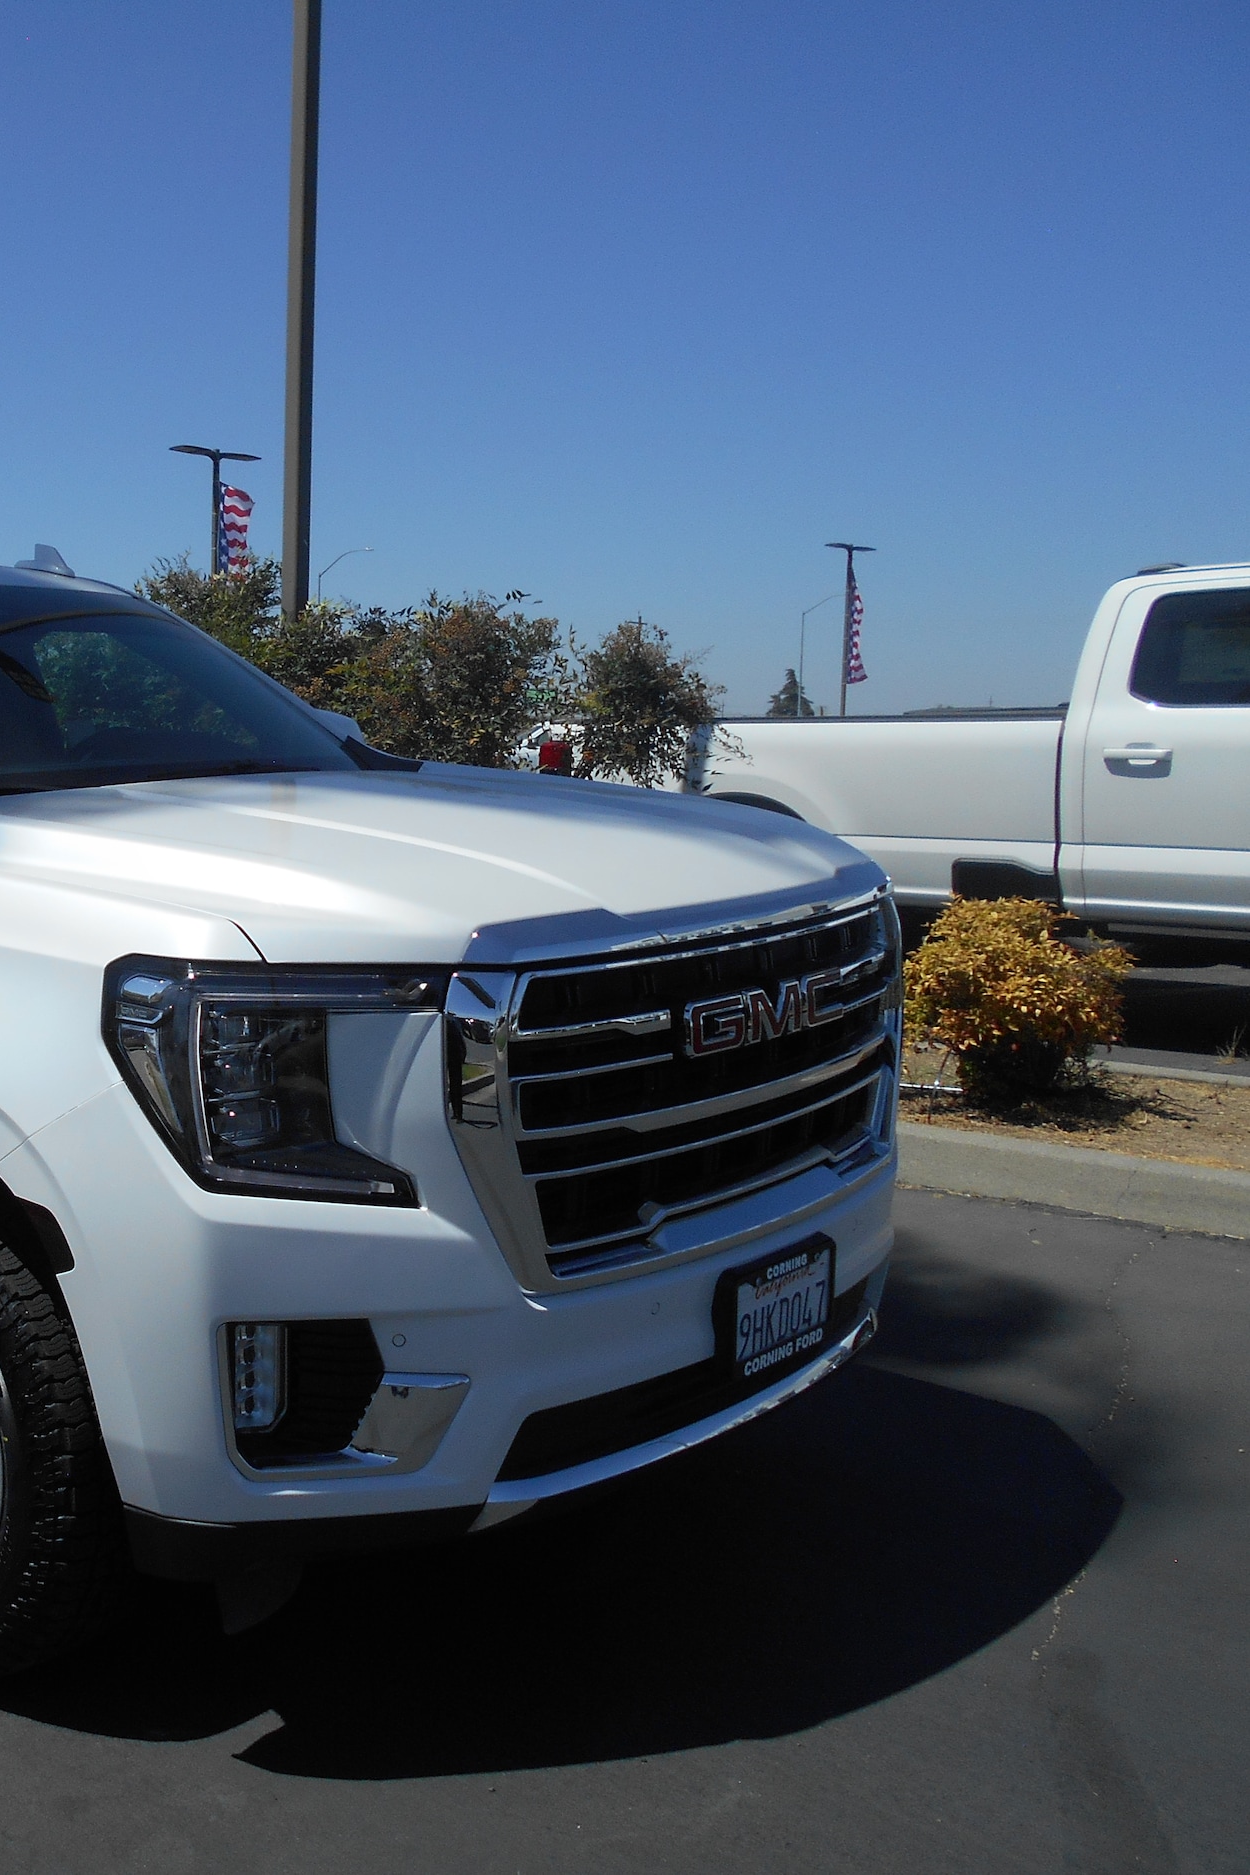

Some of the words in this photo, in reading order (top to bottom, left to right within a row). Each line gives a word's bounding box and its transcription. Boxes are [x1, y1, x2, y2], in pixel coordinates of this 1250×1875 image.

[684, 967, 844, 1058] GMC
[766, 1253, 808, 1279] CORNING
[739, 1280, 826, 1359] 9HKD047
[744, 1342, 794, 1376] CORNING
[796, 1328, 823, 1352] FORD
